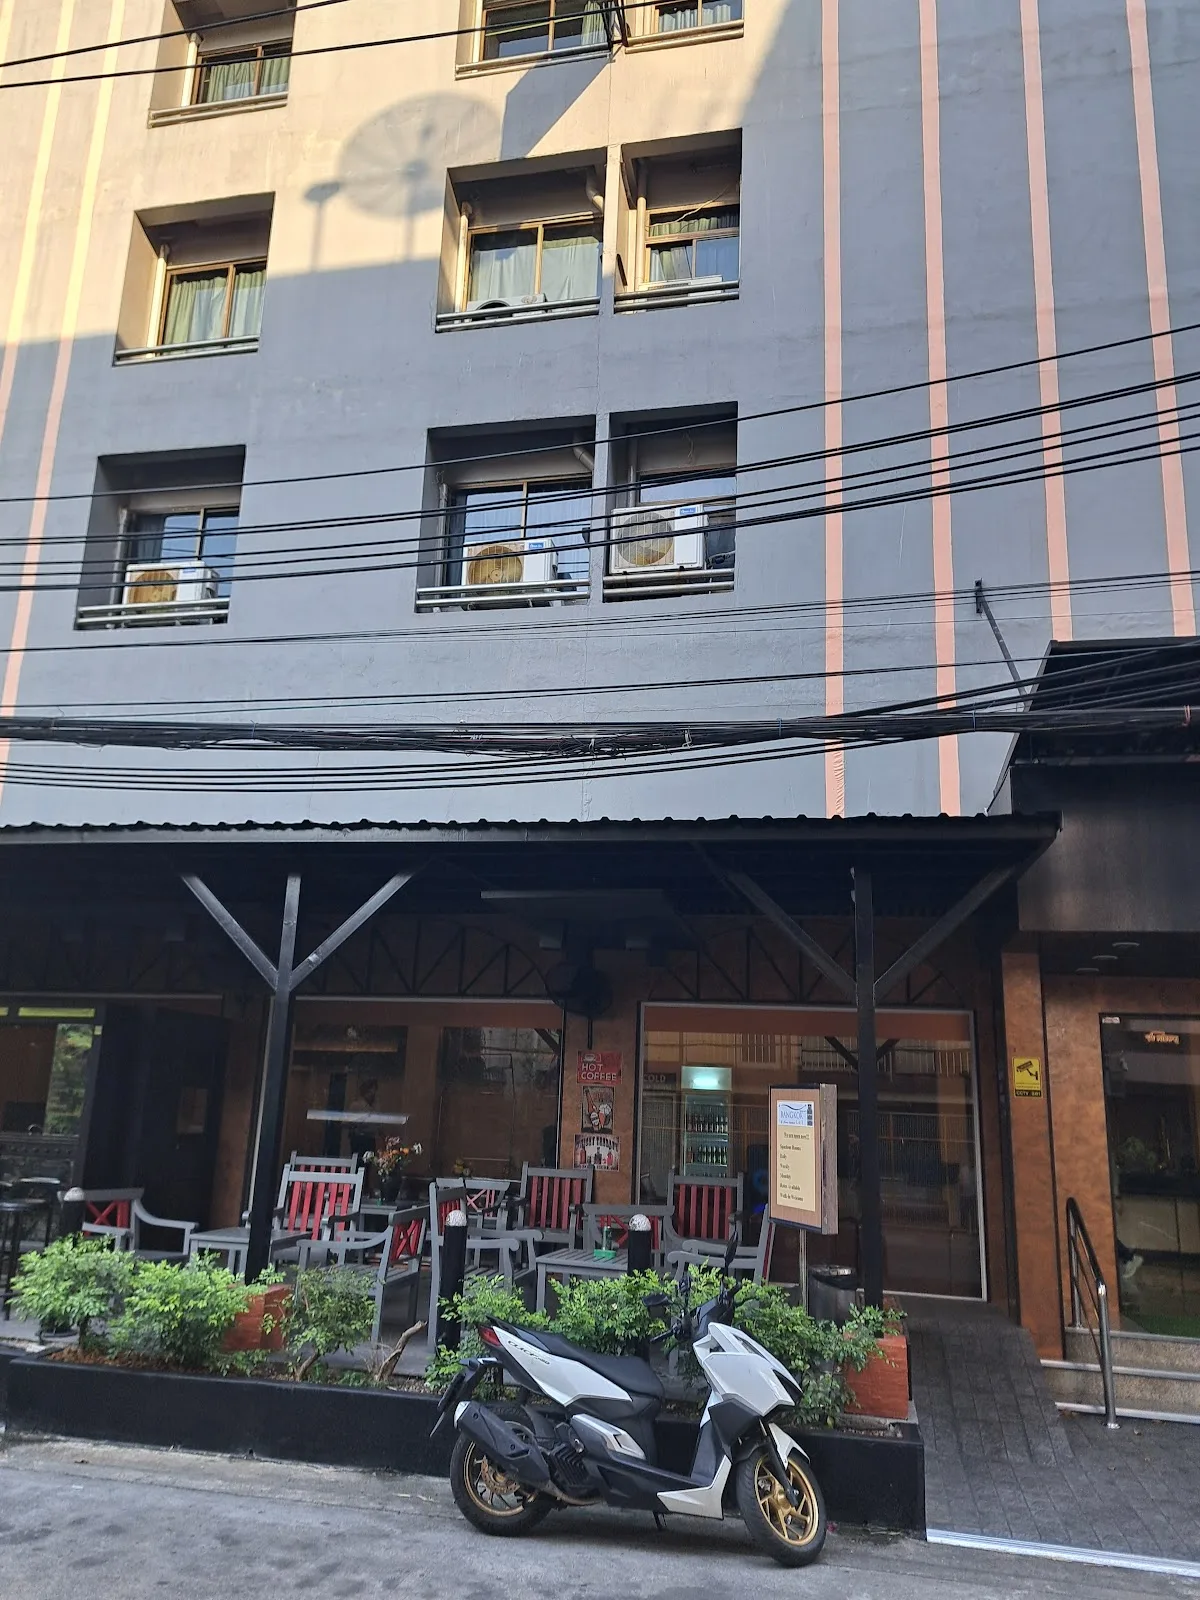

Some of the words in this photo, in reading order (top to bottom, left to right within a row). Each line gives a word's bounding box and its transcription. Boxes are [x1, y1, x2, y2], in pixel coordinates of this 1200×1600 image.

[581, 1063, 603, 1072] HOT
[581, 1072, 617, 1081] COFFEE
[644, 1073, 666, 1083] COLD
[780, 1110, 804, 1120] BANGKOK
